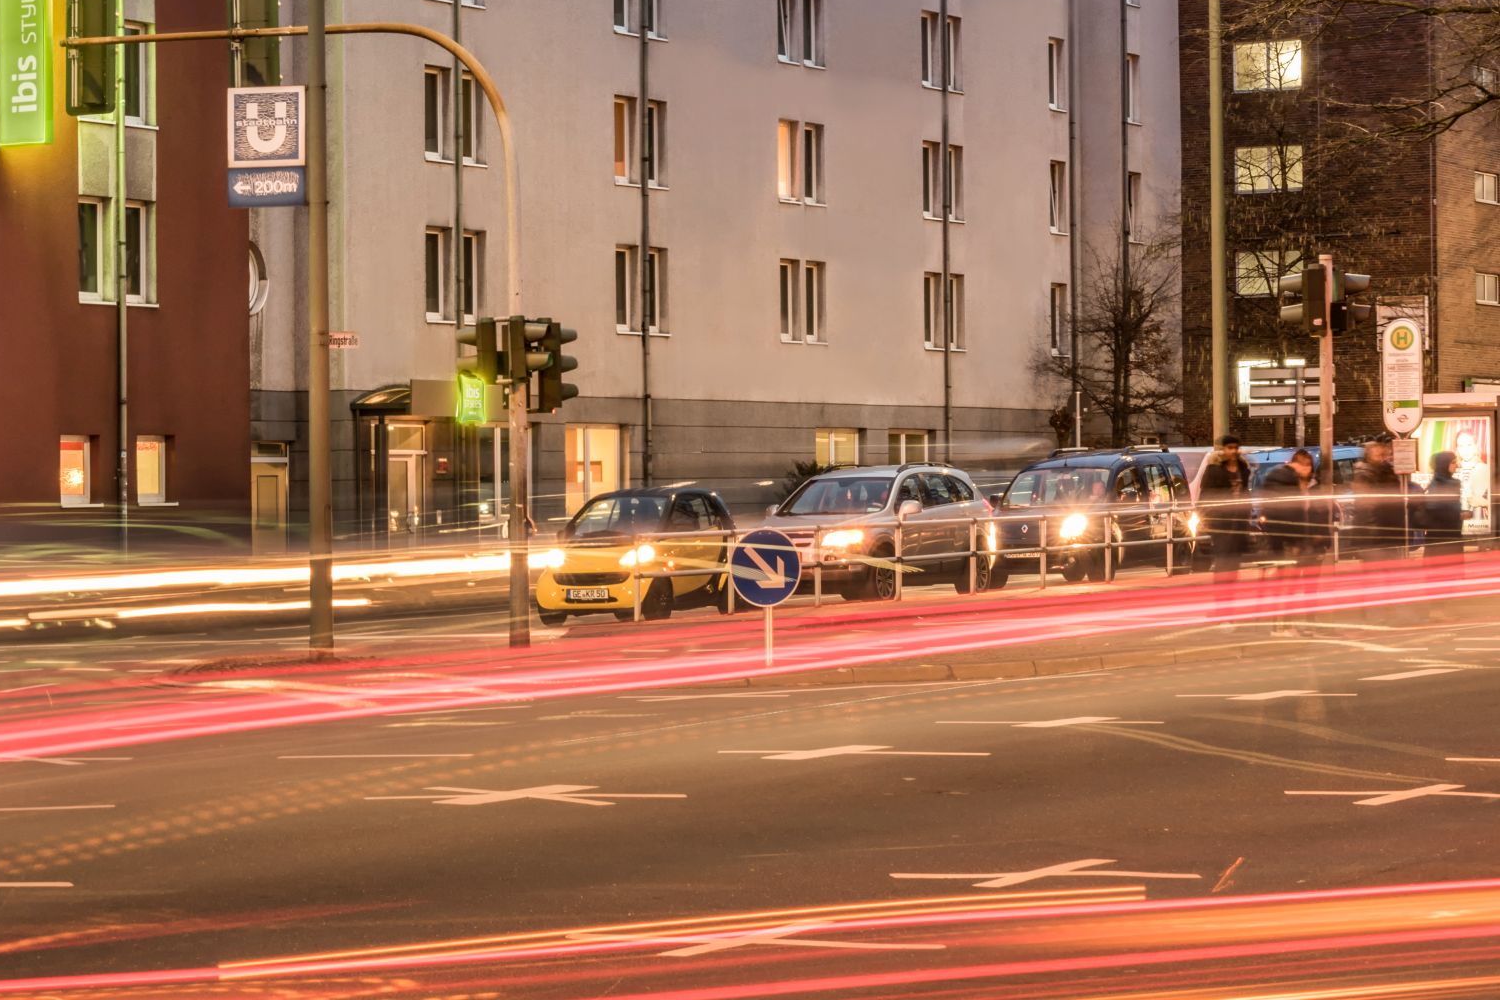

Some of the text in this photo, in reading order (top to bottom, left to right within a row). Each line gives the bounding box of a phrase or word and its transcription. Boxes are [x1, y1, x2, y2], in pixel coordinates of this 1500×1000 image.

[11, 55, 37, 113] ibis
[255, 180, 298, 194] 200m
[1396, 331, 1408, 345] H
